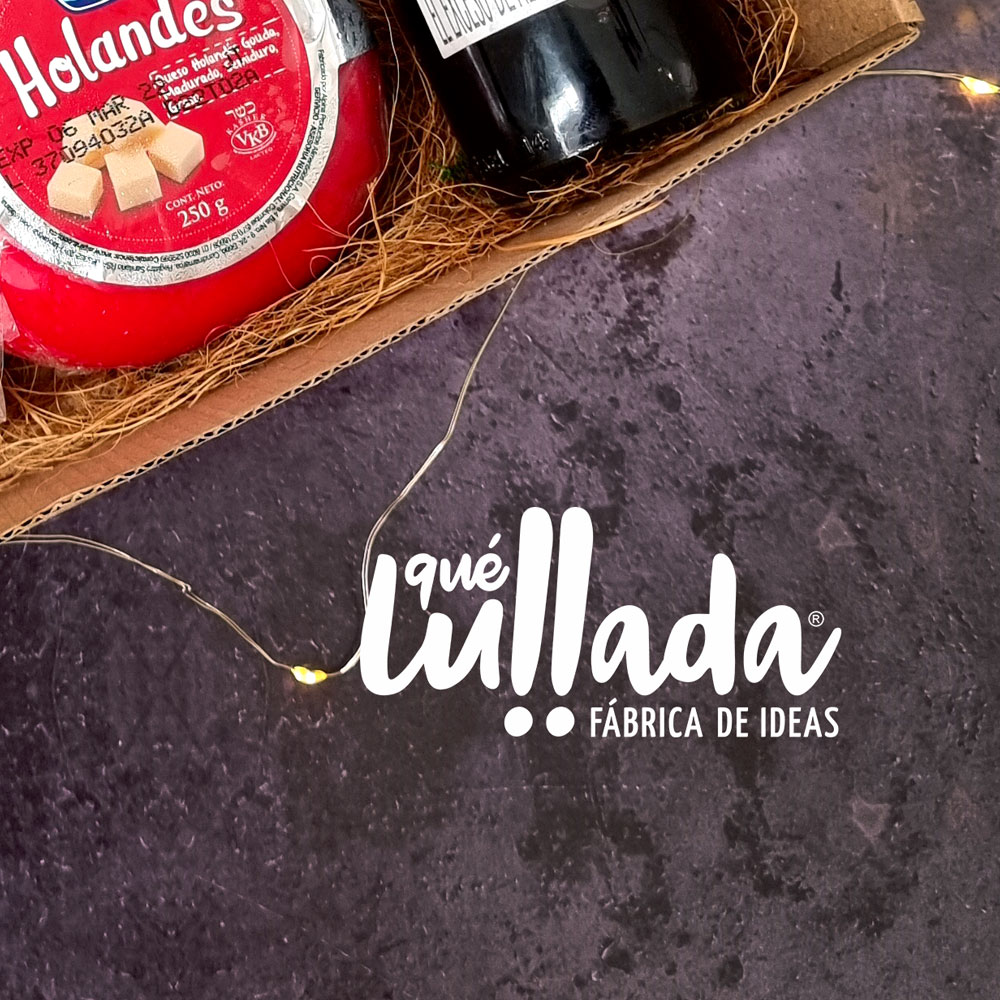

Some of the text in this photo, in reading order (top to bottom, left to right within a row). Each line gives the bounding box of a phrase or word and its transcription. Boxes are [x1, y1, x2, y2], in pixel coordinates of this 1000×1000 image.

[154, 66, 189, 87] Queso
[241, 27, 280, 49] Gouda,
[163, 67, 224, 100] Madurado,
[223, 43, 279, 72] Semiduro,
[46, 119, 79, 145] 06
[87, 95, 131, 127] MAR
[225, 101, 256, 119] כשר
[226, 113, 266, 135] KASHER
[165, 192, 195, 212] CONT.
[177, 196, 229, 228] 250 g
